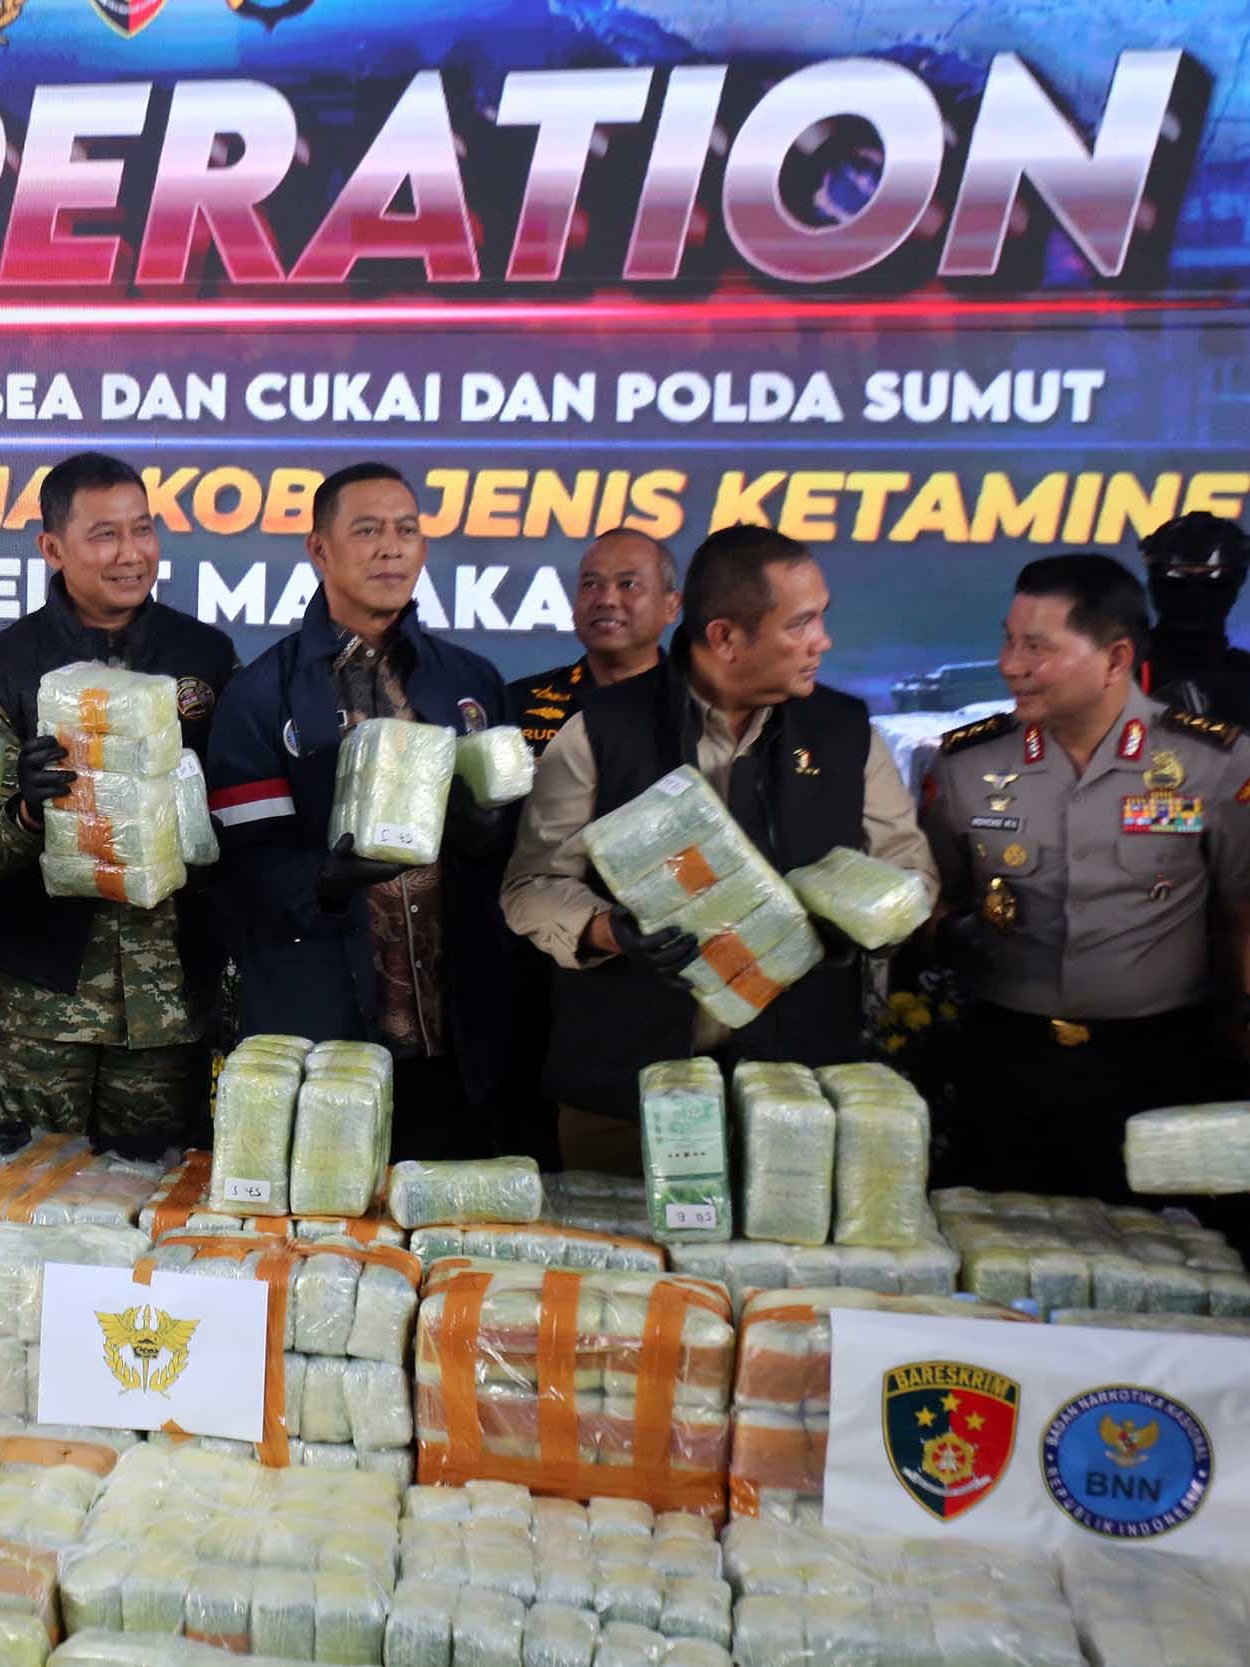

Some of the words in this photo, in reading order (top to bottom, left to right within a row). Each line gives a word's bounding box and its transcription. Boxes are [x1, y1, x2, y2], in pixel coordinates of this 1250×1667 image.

[102, 373, 227, 421] DAN
[246, 373, 441, 422] CUKAI
[461, 372, 596, 422] DAN
[617, 372, 843, 422] POLDA
[864, 370, 1105, 423] SUMUT
[421, 468, 686, 541] JENIS
[894, 1365, 1011, 1398] BARESKRIM
[1085, 1471, 1162, 1503] BNN
